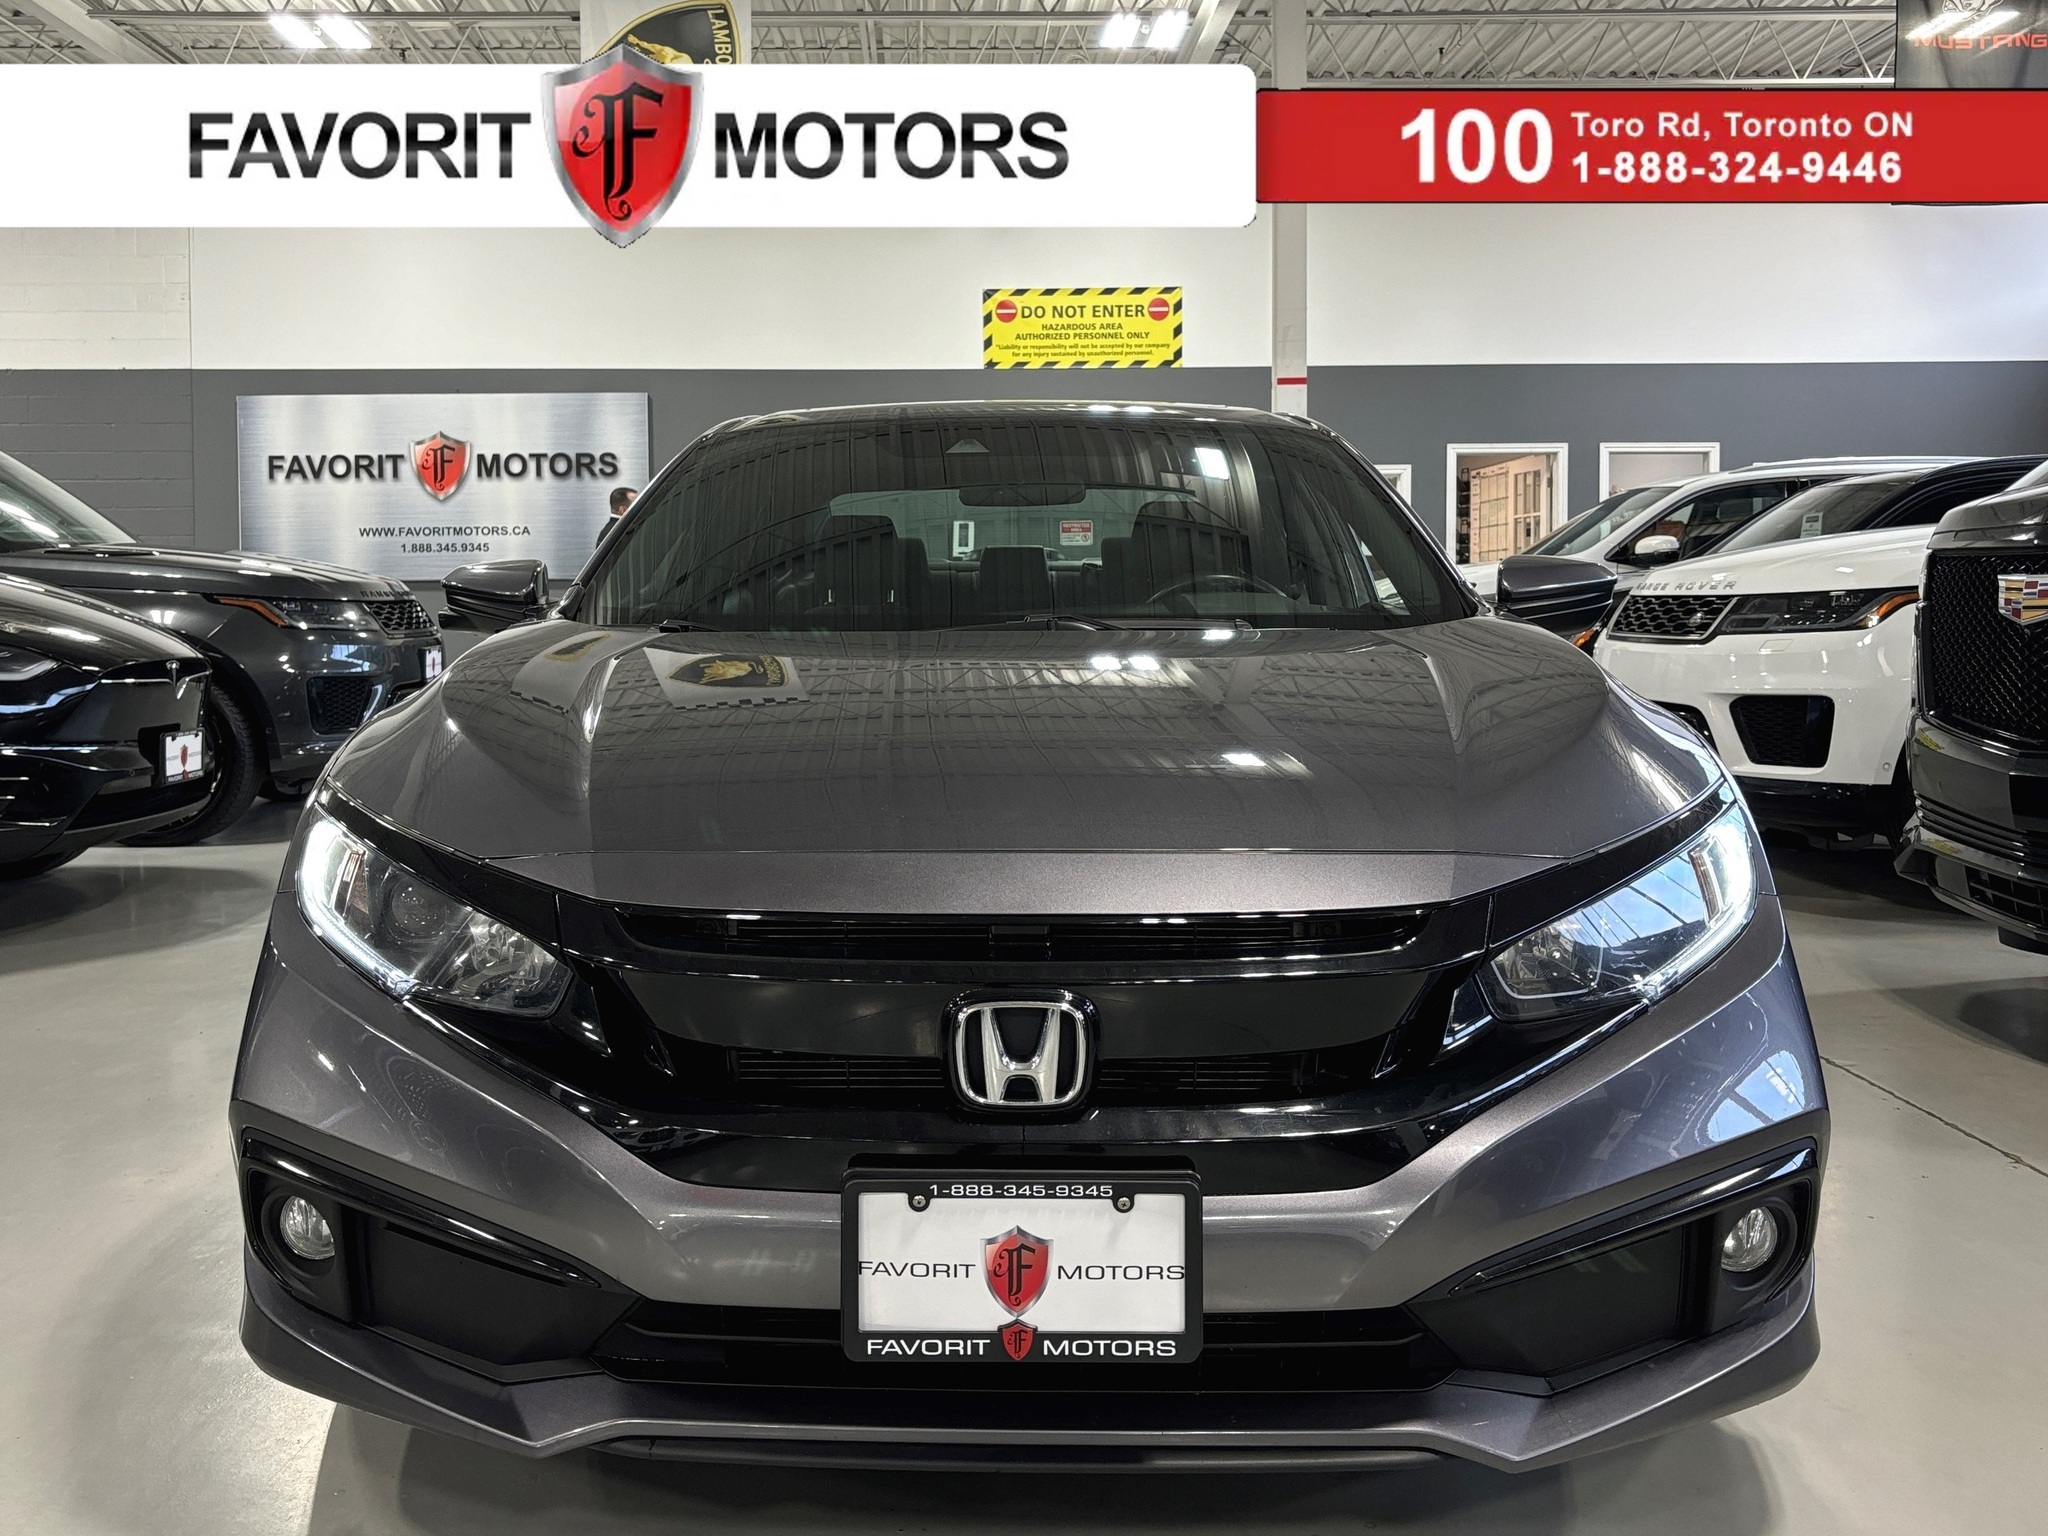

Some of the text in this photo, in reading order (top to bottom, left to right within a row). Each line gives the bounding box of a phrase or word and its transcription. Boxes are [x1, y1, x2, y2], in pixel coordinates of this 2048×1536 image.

[1912, 33, 2048, 50] MUSTANG
[1021, 304, 1145, 319] DO NOT ENTER
[1041, 322, 1123, 331] HAZARDOUS AREA
[1015, 331, 1150, 341] AUTHORIZED PERSONNEL ONLY
[268, 455, 405, 480] FAVORIT
[477, 452, 619, 479] MOTORS
[359, 526, 531, 538] WWW.FAVORITMOTORS.CA
[400, 542, 490, 553] 1.888.345.9345
[1675, 580, 1737, 591] ROVER
[929, 1184, 1113, 1197] 1-888-345-9345
[858, 1260, 976, 1279] FAVORIT
[1057, 1265, 1185, 1280] MOTORS
[867, 1339, 991, 1356] FAVORIT
[1043, 1339, 1176, 1357] MOTORS
